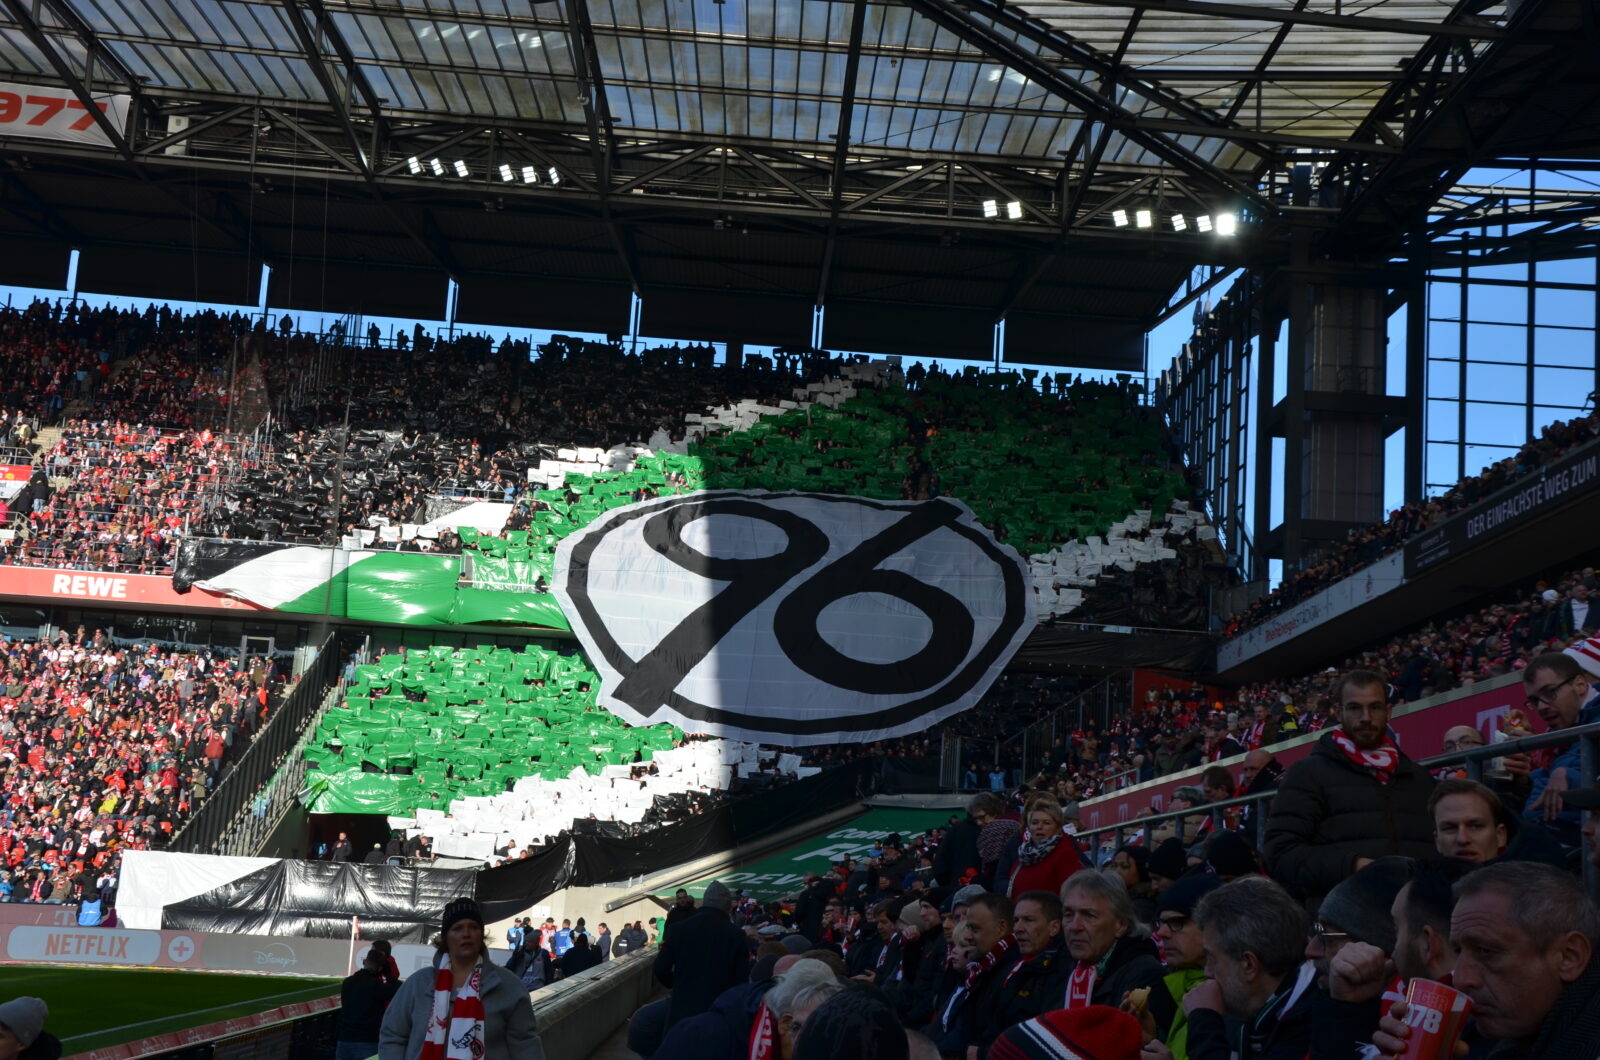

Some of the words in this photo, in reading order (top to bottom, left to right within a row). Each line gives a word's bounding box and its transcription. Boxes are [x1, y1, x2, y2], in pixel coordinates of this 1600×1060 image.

[1467, 513, 1486, 539] DER
[1486, 483, 1543, 529] EINFACHSTE
[1544, 470, 1569, 500] WEG
[1571, 455, 1598, 488] ZUM
[53, 574, 128, 598] REWE
[612, 497, 975, 718] 96
[44, 933, 130, 960] NETFLIX
